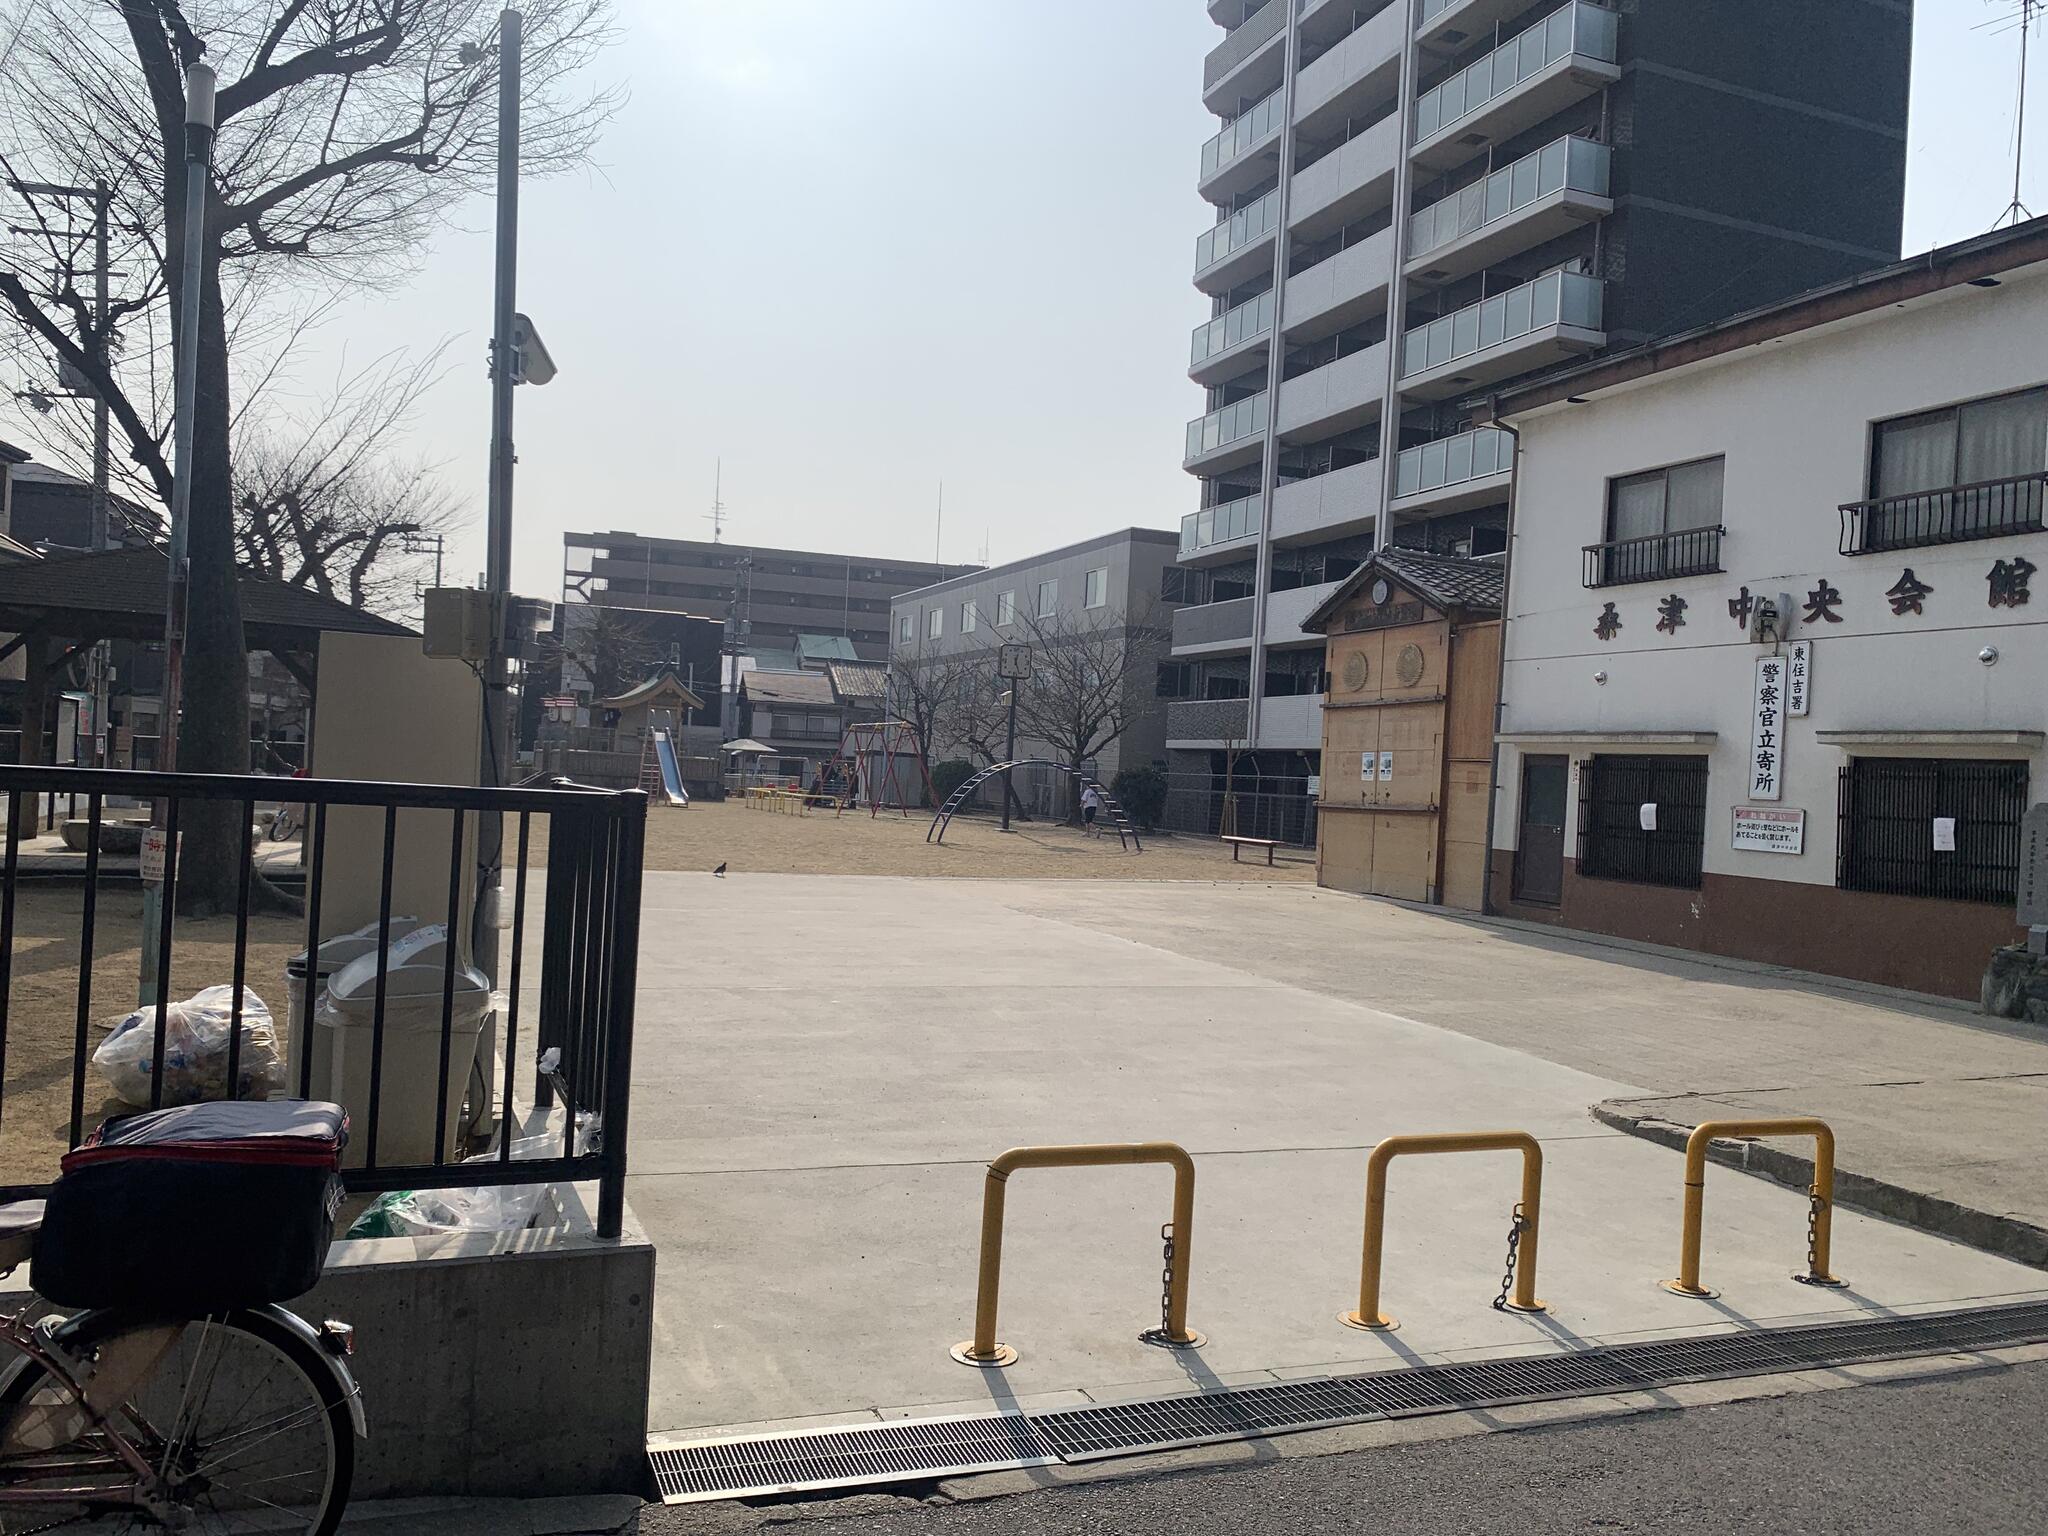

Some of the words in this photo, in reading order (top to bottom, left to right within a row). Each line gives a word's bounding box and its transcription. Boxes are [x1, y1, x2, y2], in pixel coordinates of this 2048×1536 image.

[1791, 646, 1805, 710] 東住吉署
[1755, 663, 1780, 793] 警察官立寄所
